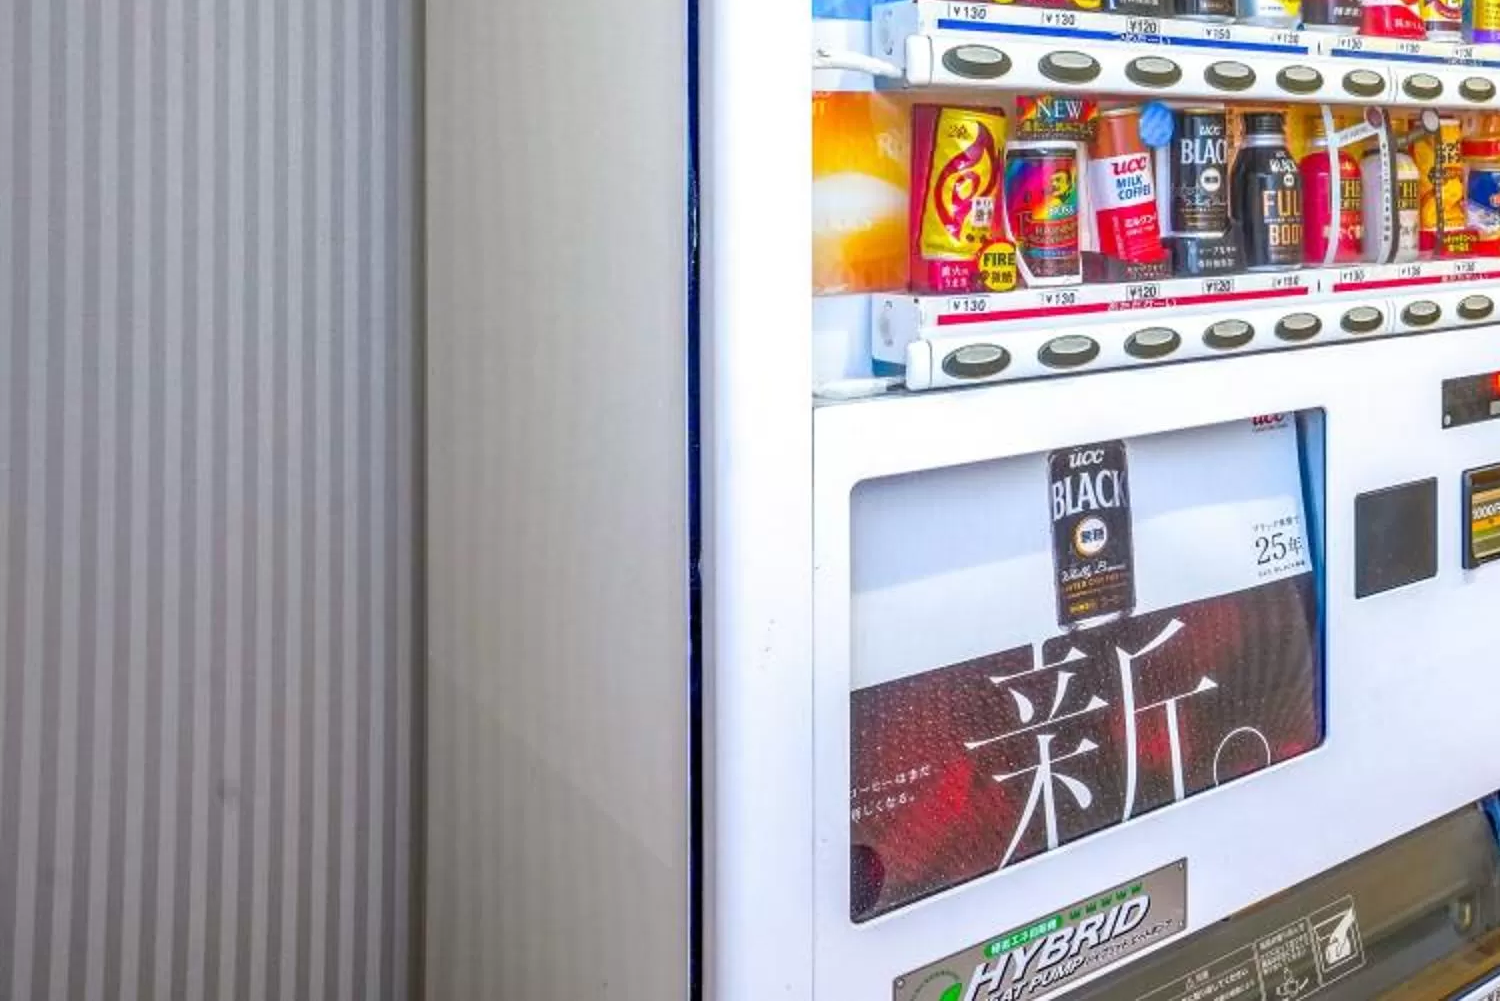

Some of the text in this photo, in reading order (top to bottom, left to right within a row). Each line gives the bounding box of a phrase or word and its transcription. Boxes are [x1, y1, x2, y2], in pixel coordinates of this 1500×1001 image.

[953, 4, 987, 20] ¥130
[1129, 19, 1158, 34] ¥120
[1036, 99, 1084, 120] NEW
[1181, 138, 1228, 165] BLAC
[1116, 175, 1144, 190] MILK
[1263, 190, 1303, 216] FUL
[1269, 225, 1304, 247] BOD
[984, 252, 1016, 269] FIRE
[1130, 285, 1158, 299] ¥120
[1206, 280, 1232, 294] ¥120
[953, 299, 987, 312] ¥130
[1051, 469, 1126, 521] BLACK
[1254, 532, 1303, 566] 25年
[963, 894, 1151, 1001] HYBRID
